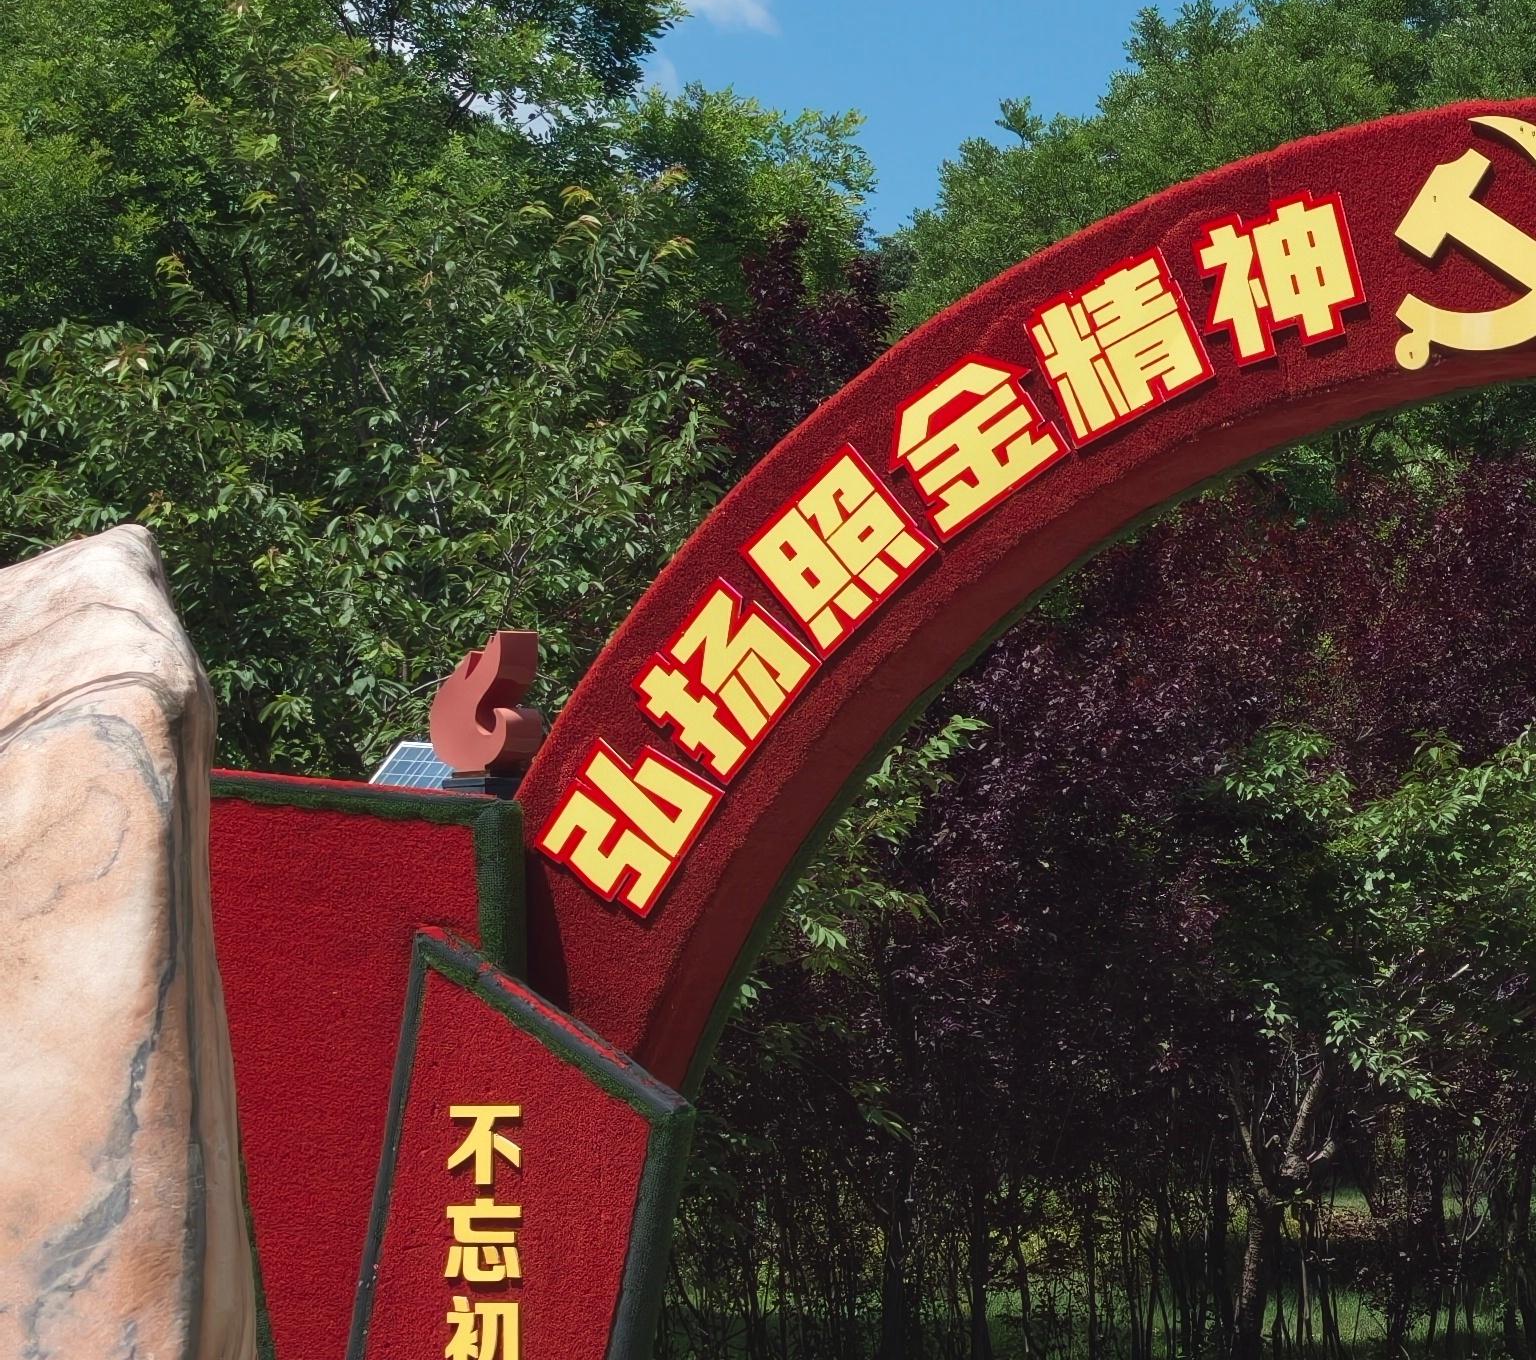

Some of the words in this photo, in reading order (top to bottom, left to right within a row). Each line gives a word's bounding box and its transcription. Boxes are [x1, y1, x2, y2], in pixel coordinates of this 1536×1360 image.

[541, 200, 1356, 910] 弘扬照金精神
